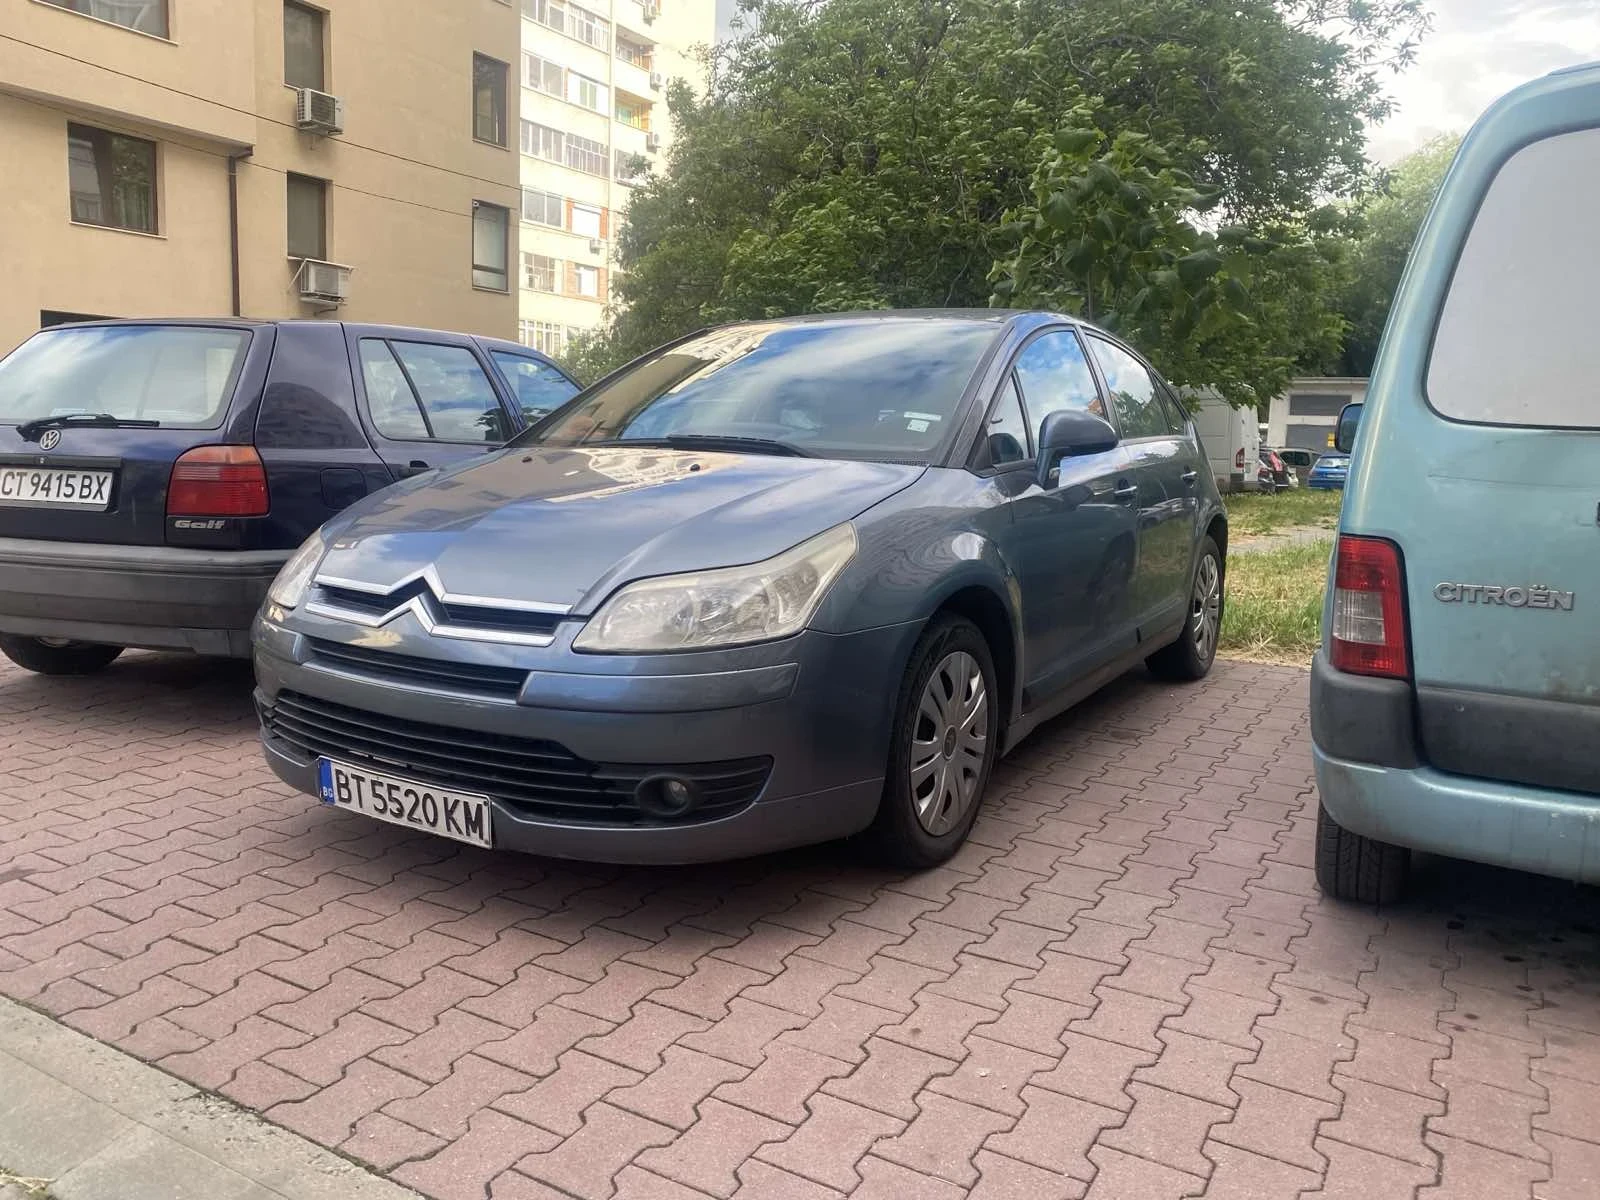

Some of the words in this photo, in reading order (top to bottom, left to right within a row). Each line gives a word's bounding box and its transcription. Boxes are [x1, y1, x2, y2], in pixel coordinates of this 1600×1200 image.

[1433, 582, 1574, 610] CITROËN
[335, 768, 366, 809] BT
[370, 779, 438, 828] 5520
[443, 796, 484, 840] KM
